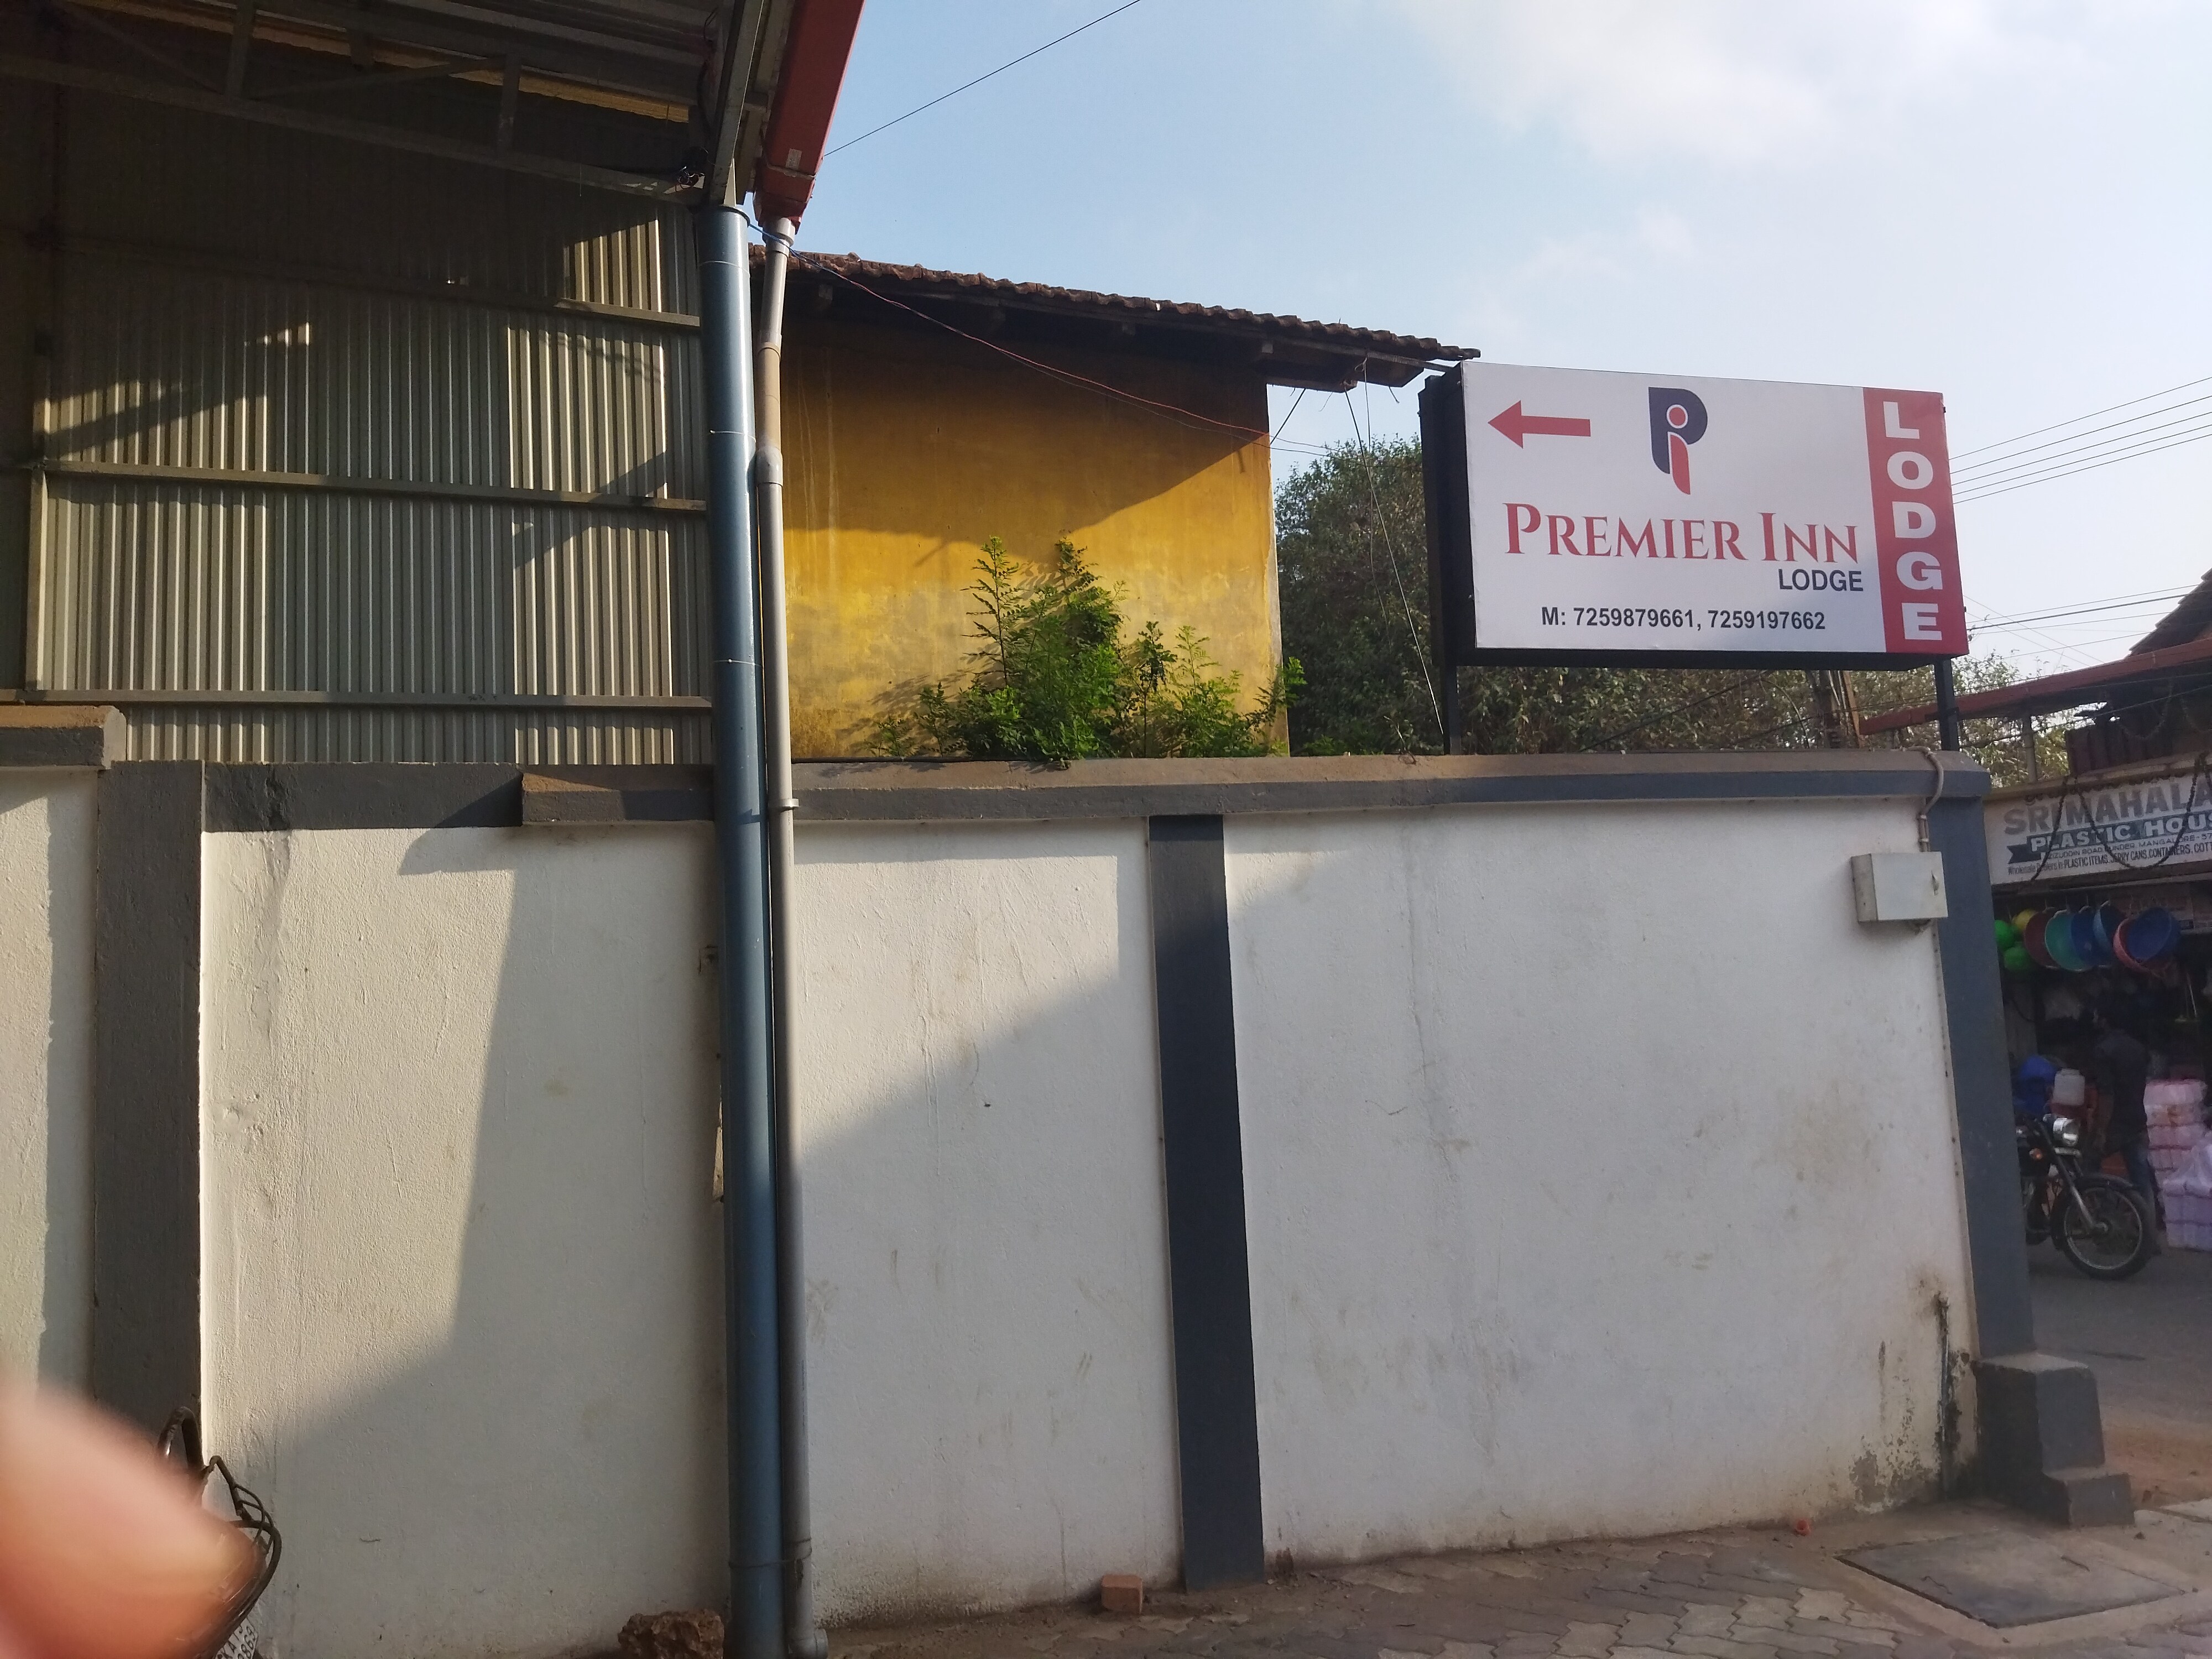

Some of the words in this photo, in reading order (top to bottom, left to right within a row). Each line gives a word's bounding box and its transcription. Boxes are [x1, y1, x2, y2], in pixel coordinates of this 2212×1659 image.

[1882, 401, 1943, 641] LODGE
[1778, 568, 1864, 592] LODGE
[1541, 607, 1566, 626] M:
[1573, 608, 1702, 632] 7259879661,
[1708, 611, 1826, 630] 7259197662
[2031, 824, 2131, 852] PLASTIC
